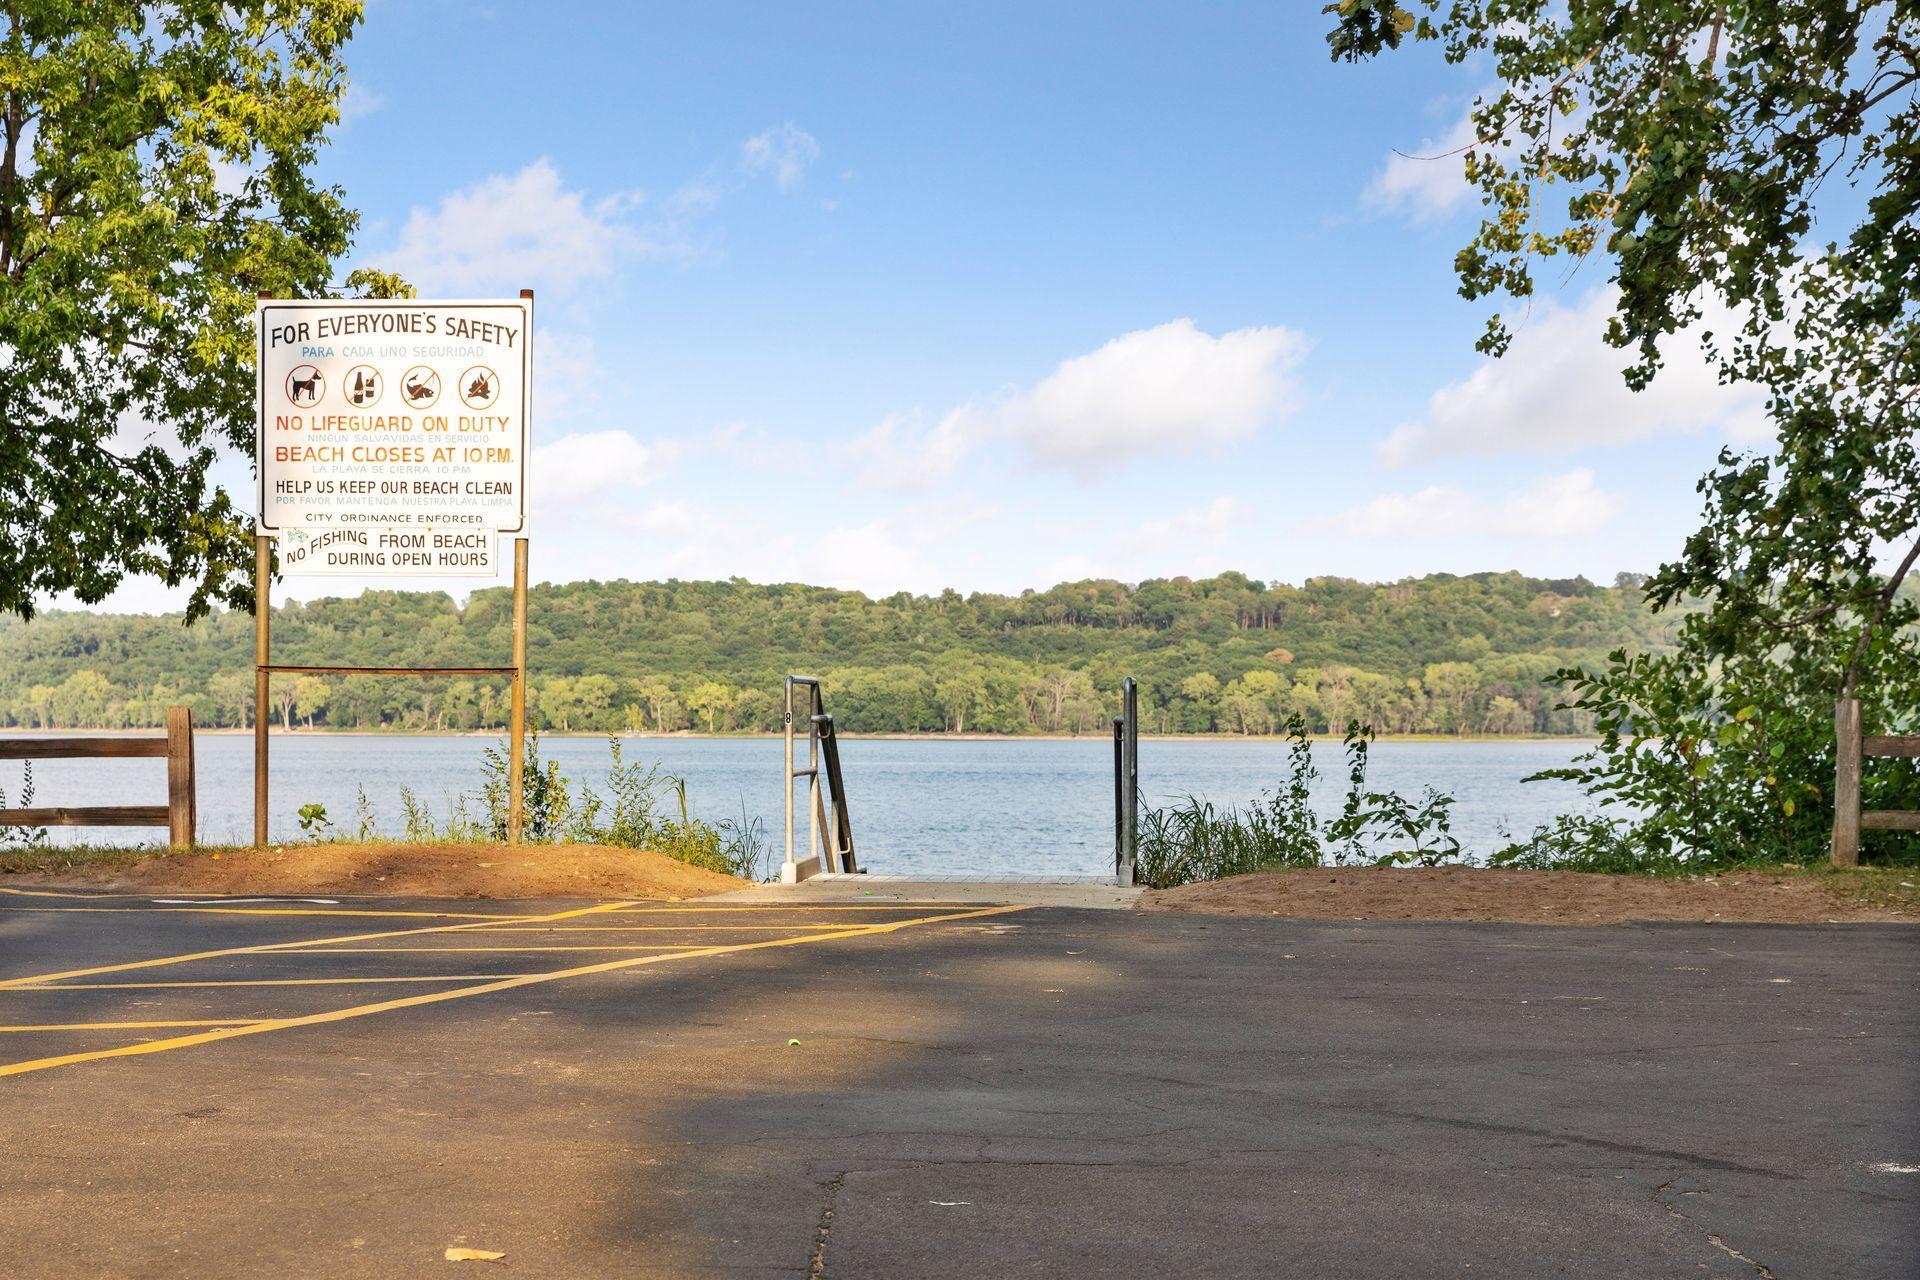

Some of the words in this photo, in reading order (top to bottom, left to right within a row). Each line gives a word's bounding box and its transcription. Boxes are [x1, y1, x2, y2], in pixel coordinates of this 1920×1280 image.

[271, 322, 310, 348] FOR
[318, 312, 436, 338] EVERYONE'S
[445, 317, 518, 348] SAFETY
[302, 346, 334, 357] PARA
[342, 346, 374, 357] CADA
[380, 346, 406, 357] UNO
[413, 346, 484, 357] SEGURIDAD
[276, 416, 302, 431] NO
[312, 416, 412, 431] LIFEGUARD
[422, 416, 448, 431] ON
[459, 416, 510, 432] DUTY
[354, 434, 424, 443] SALVAVIDAS
[428, 435, 441, 443] EN
[445, 434, 489, 443] SERVICIO
[276, 446, 344, 462] BEACH
[352, 446, 424, 462] CLOSES
[432, 447, 456, 462] AT
[312, 465, 327, 474] LA
[332, 465, 367, 474] PLAYA
[372, 465, 384, 474] SE
[389, 465, 430, 474] CIERRA
[437, 466, 449, 474] 10
[276, 480, 312, 494] HELP
[316, 480, 334, 494] US
[340, 480, 376, 494] KEEP
[381, 481, 408, 494] OUR
[413, 481, 458, 494] BEACH
[466, 482, 512, 495] CLEAN
[275, 496, 295, 505] POR
[300, 496, 330, 505] FAVOR
[336, 497, 397, 506] MANTENGA
[402, 497, 446, 506] NUESTRA
[450, 498, 477, 506] PLAYA
[482, 498, 513, 506] LIMPIA
[306, 513, 333, 521] CITY
[340, 513, 412, 522] ORDINANCE
[418, 514, 483, 523] ENFORCED
[287, 547, 306, 564] NO
[311, 530, 368, 555] FISHING
[379, 535, 425, 548] FROM
[433, 535, 486, 548] BEACH
[328, 552, 385, 565] DURING
[392, 553, 432, 566] OPEN
[439, 553, 488, 566] HOURS
[785, 712, 791, 723] 8
